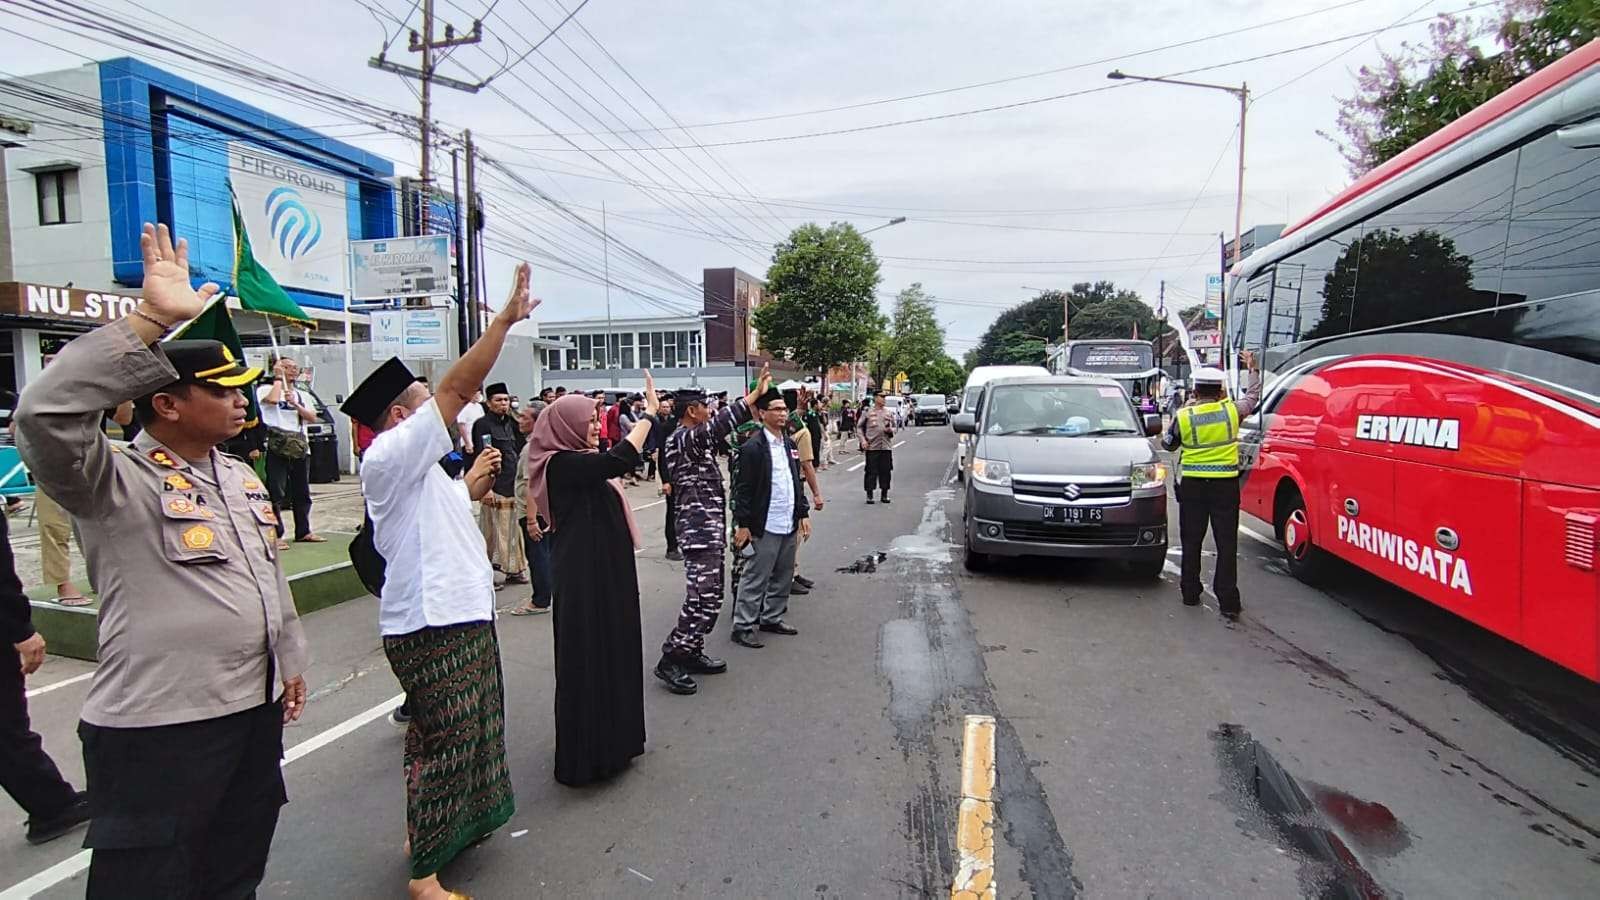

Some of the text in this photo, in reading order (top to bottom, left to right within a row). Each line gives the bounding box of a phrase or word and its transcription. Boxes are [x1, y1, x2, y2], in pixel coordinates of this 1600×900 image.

[240, 155, 337, 194] FIFGROUP
[304, 272, 330, 282] ASTRA
[26, 285, 143, 320] NU_STO
[1355, 414, 1460, 450] ERVINA
[1043, 507, 1102, 520] DK 1191 FS
[1336, 514, 1473, 596] PARIWISATA
